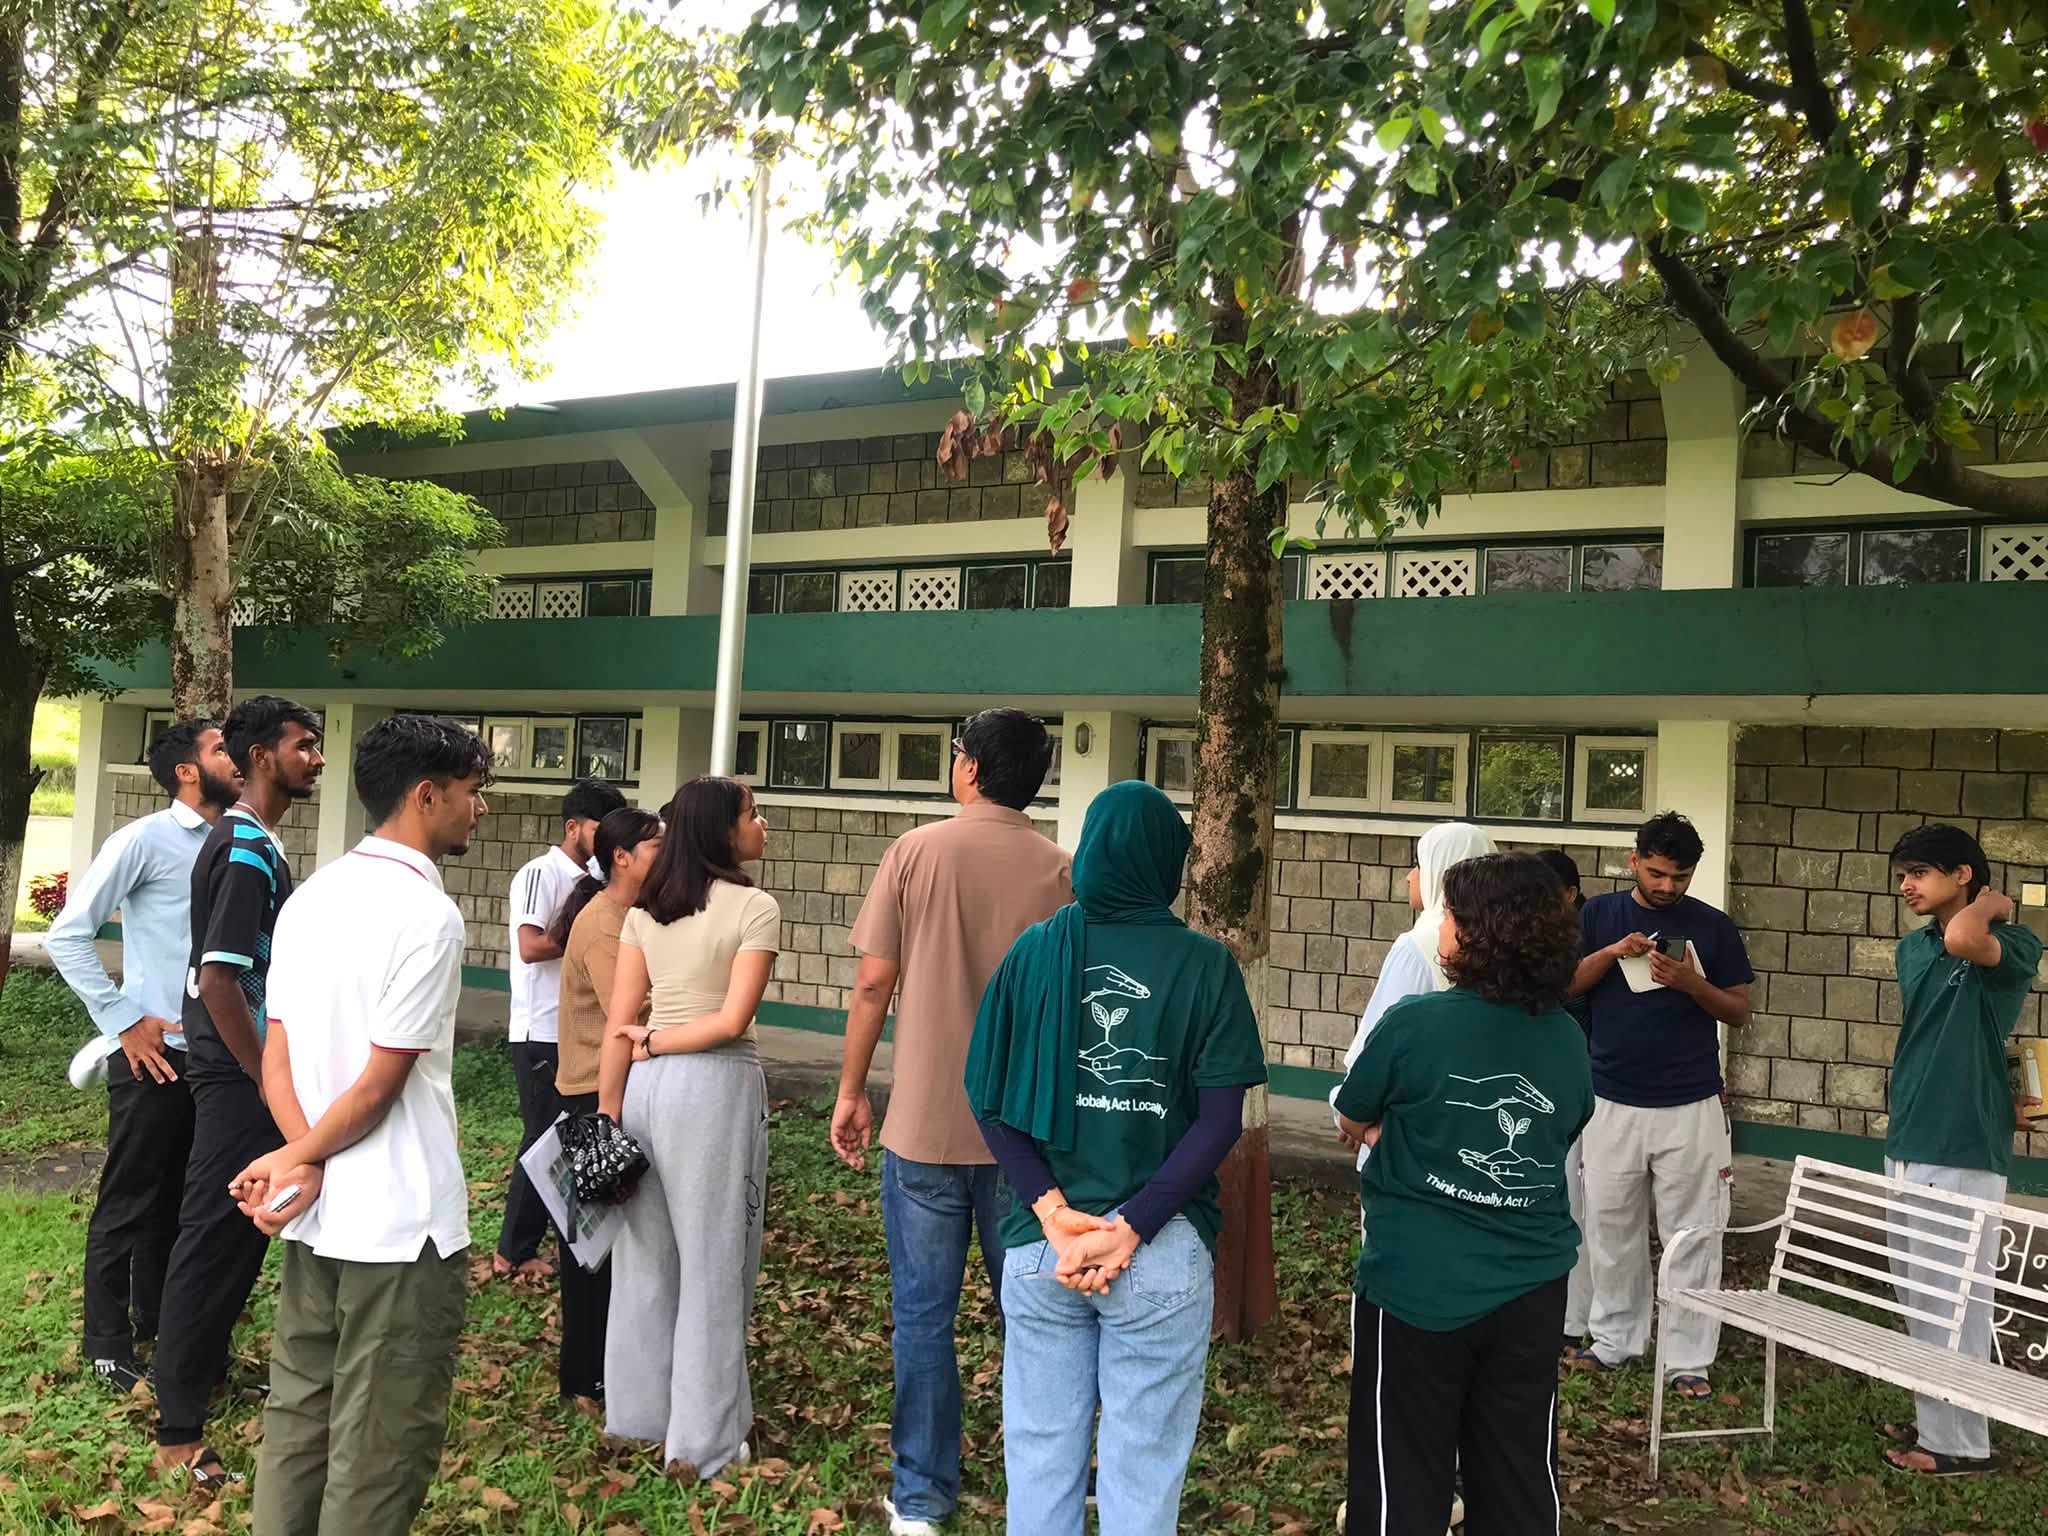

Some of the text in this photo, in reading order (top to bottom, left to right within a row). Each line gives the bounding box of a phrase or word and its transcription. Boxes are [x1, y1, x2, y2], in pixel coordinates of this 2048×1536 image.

[1111, 1097, 1131, 1112] Act
[1132, 1098, 1168, 1120] Locally
[1425, 1172, 1458, 1197] Think
[1457, 1188, 1503, 1208] Globally,
[1504, 1196, 1522, 1208] Act
